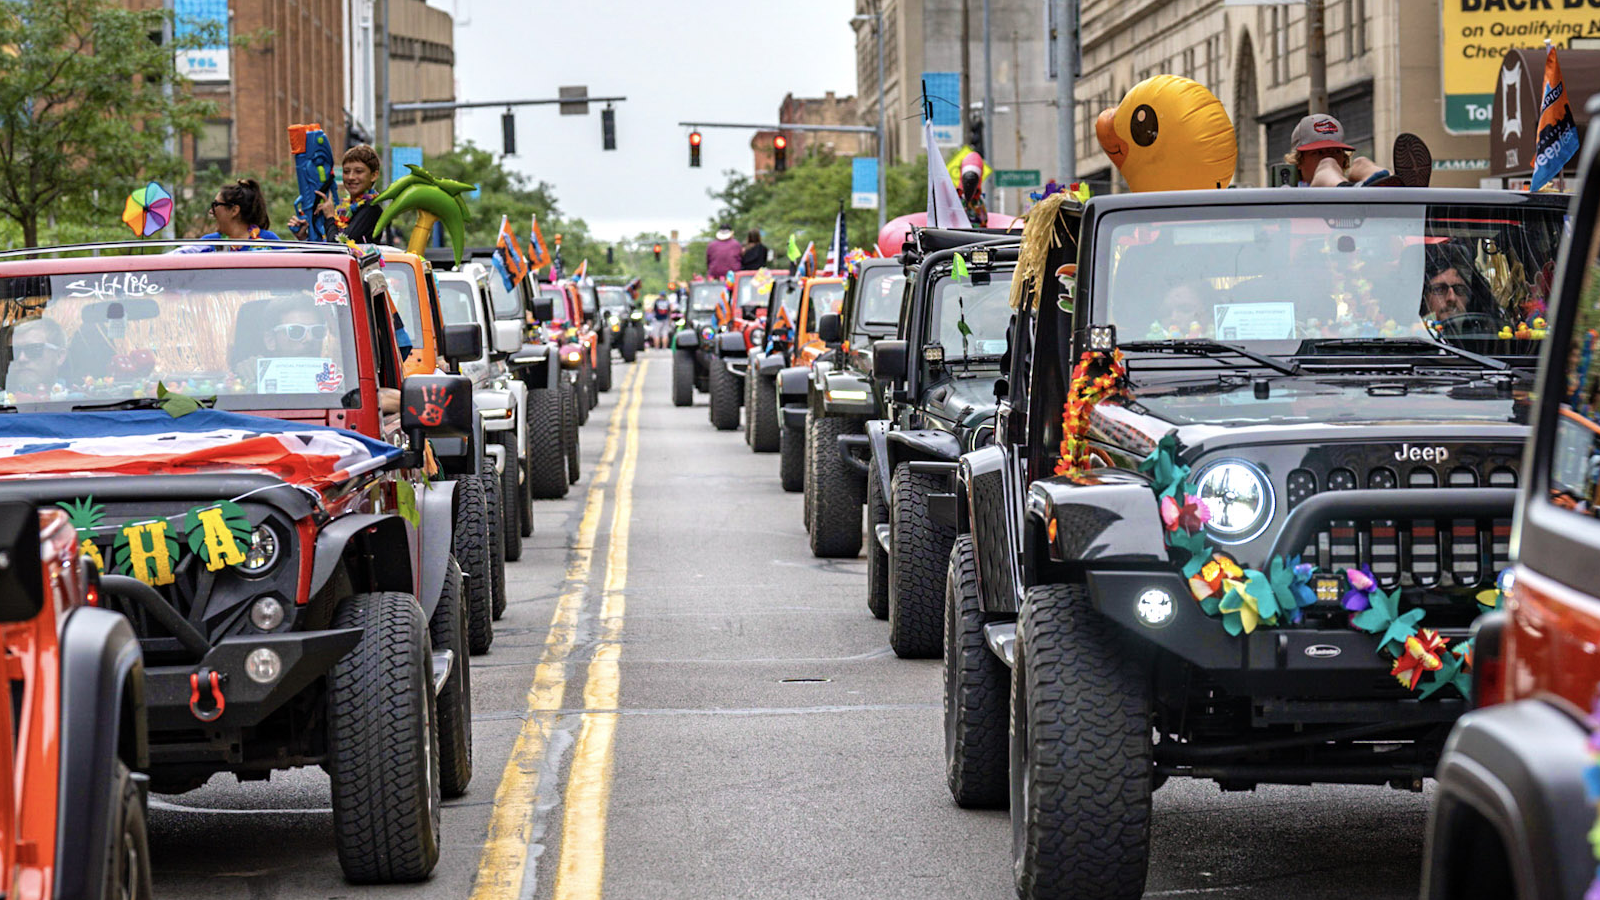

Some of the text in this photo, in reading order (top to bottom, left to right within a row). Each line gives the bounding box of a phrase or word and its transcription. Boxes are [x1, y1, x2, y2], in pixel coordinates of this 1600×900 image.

[1462, 25, 1484, 38] on
[1490, 20, 1583, 37] Qualifying
[1394, 443, 1449, 464] Jeep
